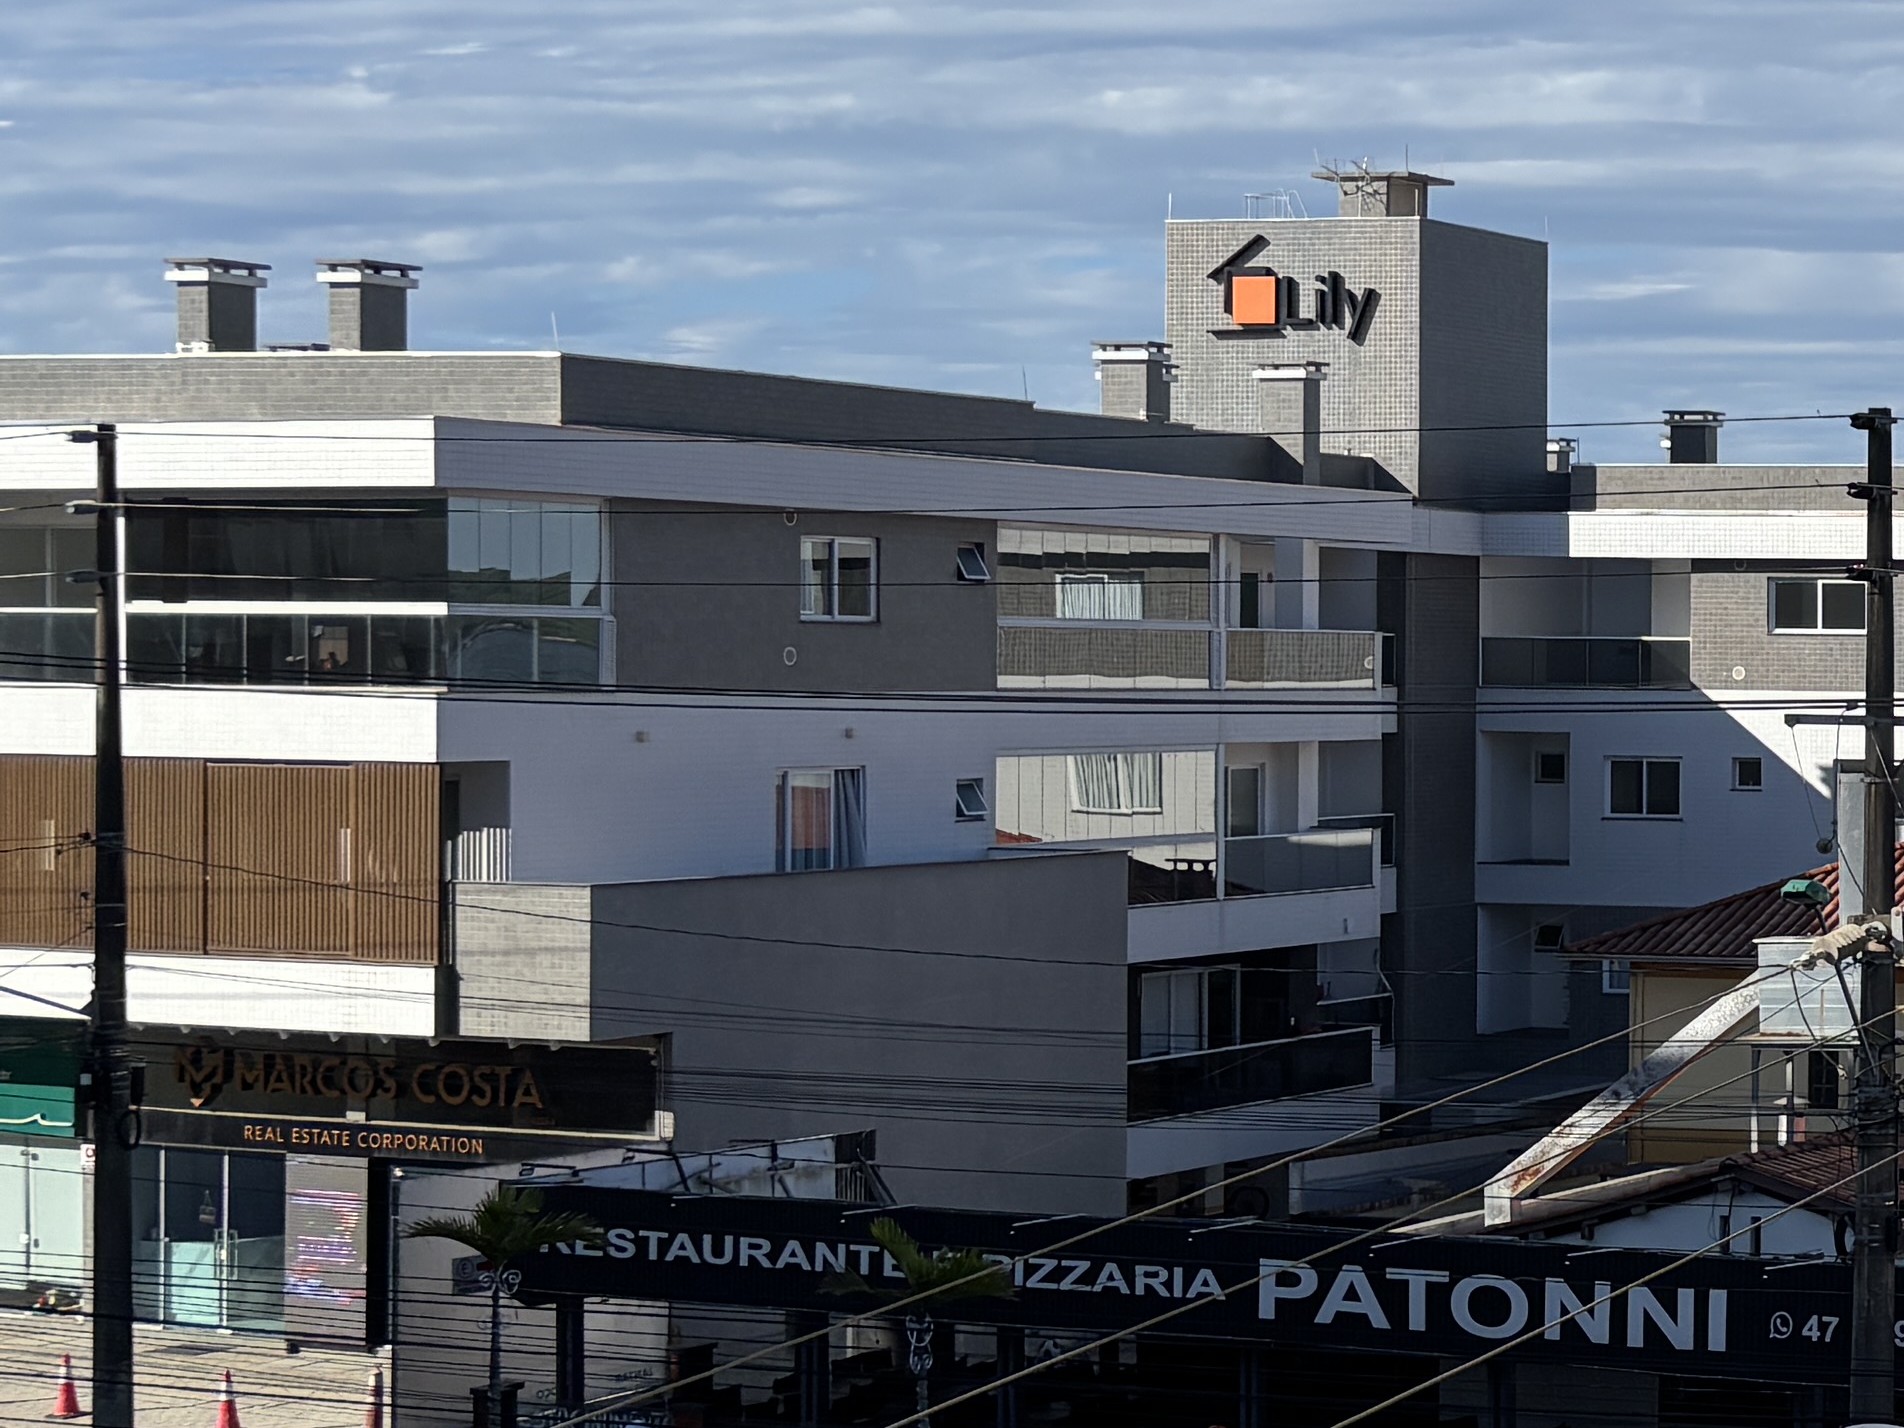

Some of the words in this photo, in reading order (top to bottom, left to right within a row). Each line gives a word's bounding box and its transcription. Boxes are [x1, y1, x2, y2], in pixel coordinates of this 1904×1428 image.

[1281, 271, 1380, 346] Lily
[234, 1052, 397, 1100] MARCOS
[412, 1062, 543, 1108] COSTA
[243, 1125, 284, 1142] REAL
[291, 1128, 349, 1147] ESTATE
[358, 1133, 483, 1154] CORPORATION
[1258, 1258, 1727, 1352] PATONNI
[1801, 1314, 1840, 1342] 47
